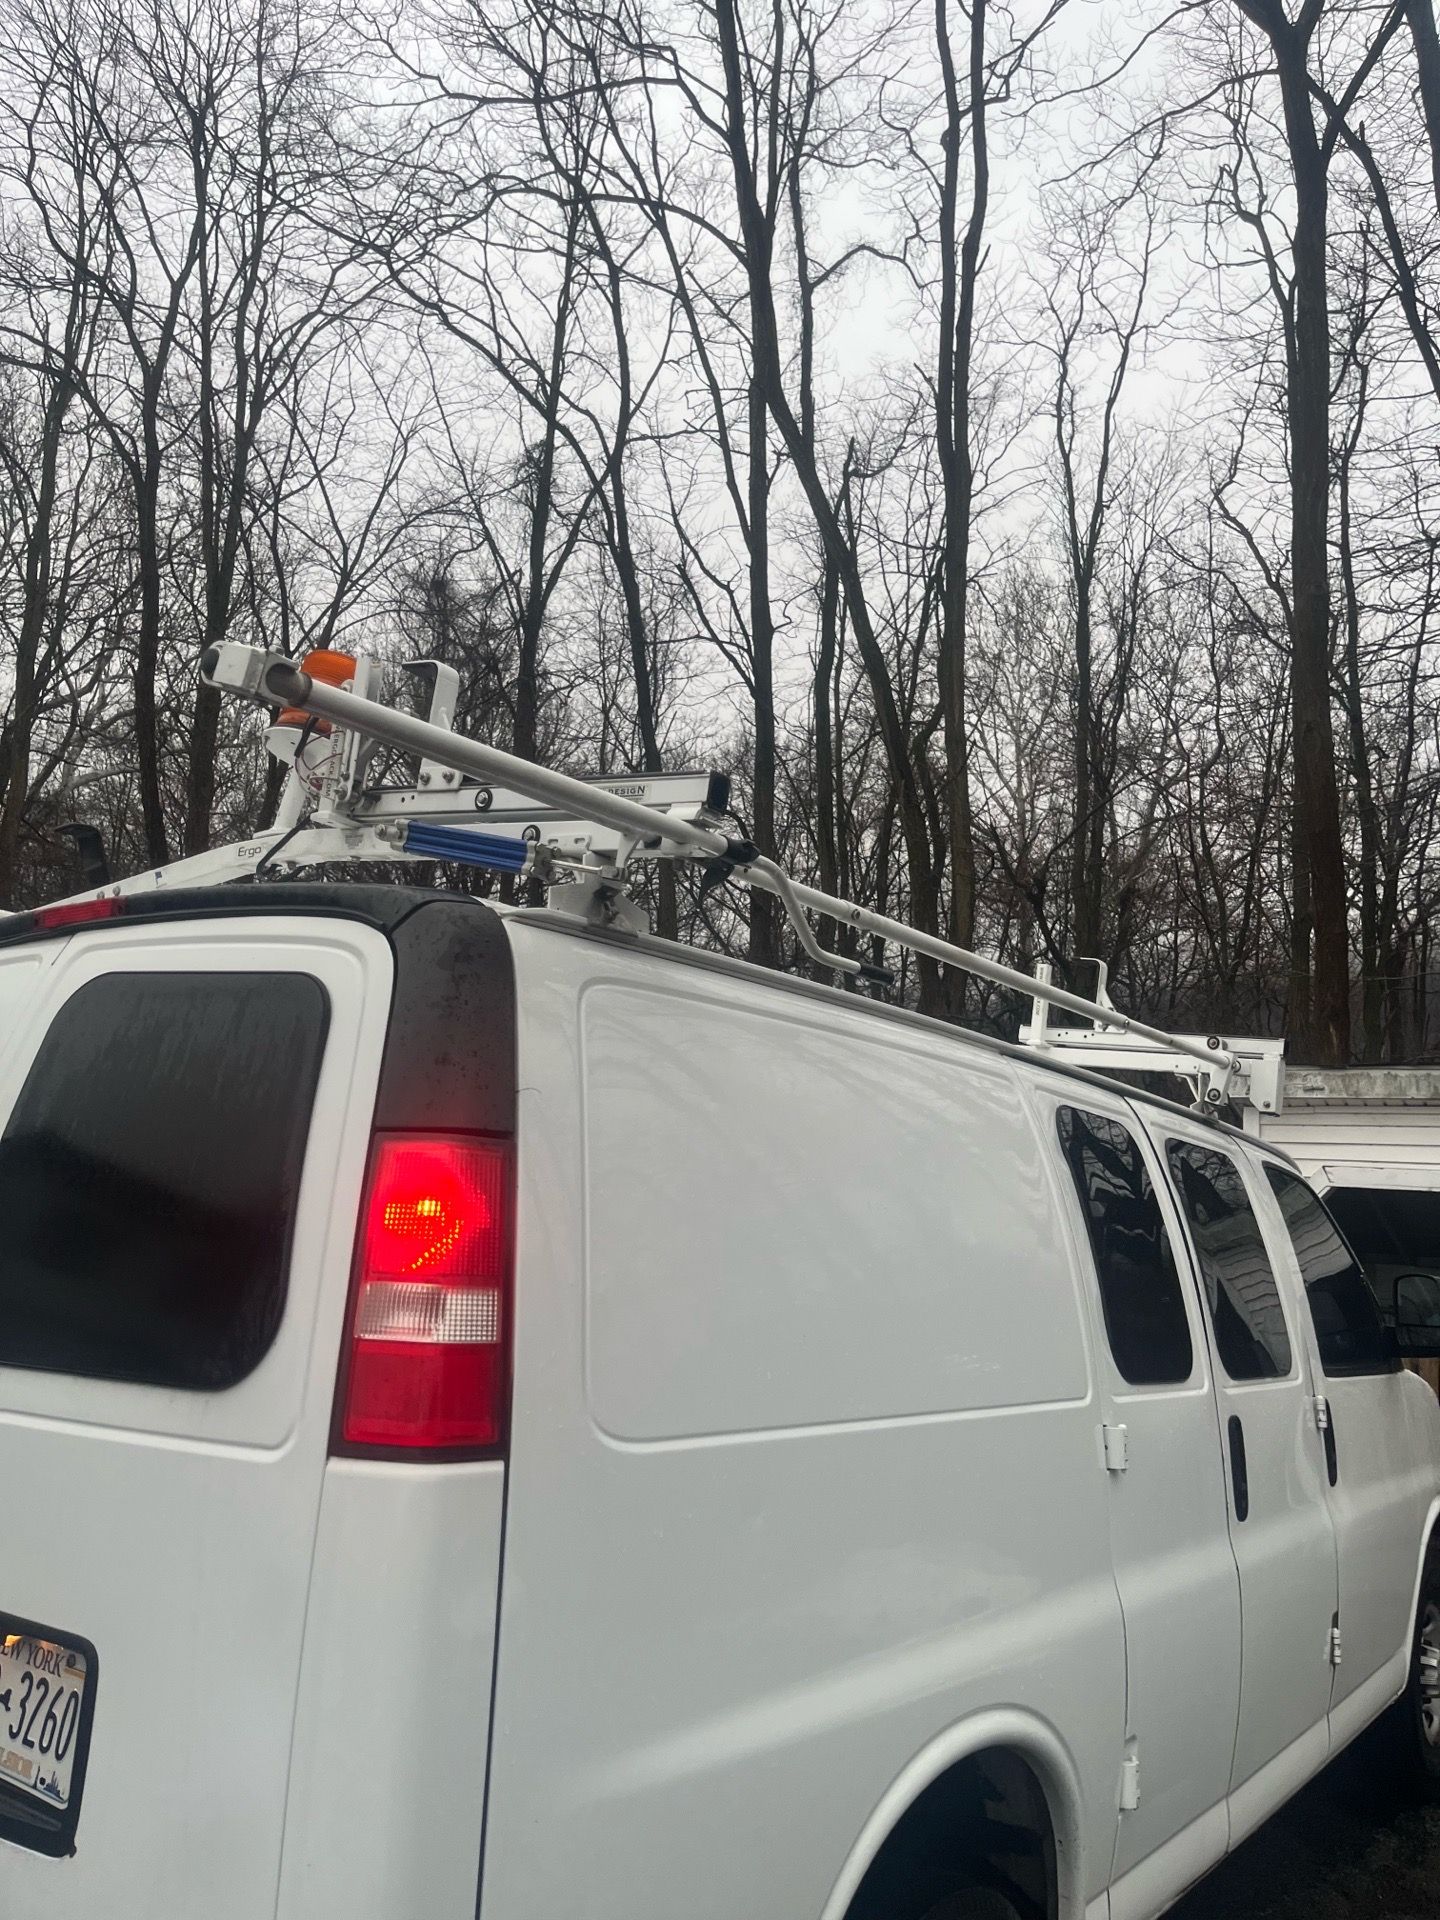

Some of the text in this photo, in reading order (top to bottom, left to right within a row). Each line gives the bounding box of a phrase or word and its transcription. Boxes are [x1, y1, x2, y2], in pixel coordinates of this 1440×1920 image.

[237, 846, 262, 858] Ergo
[0, 1640, 24, 1661] EW
[26, 1643, 65, 1678] YORK
[9, 1671, 79, 1761] 3260
